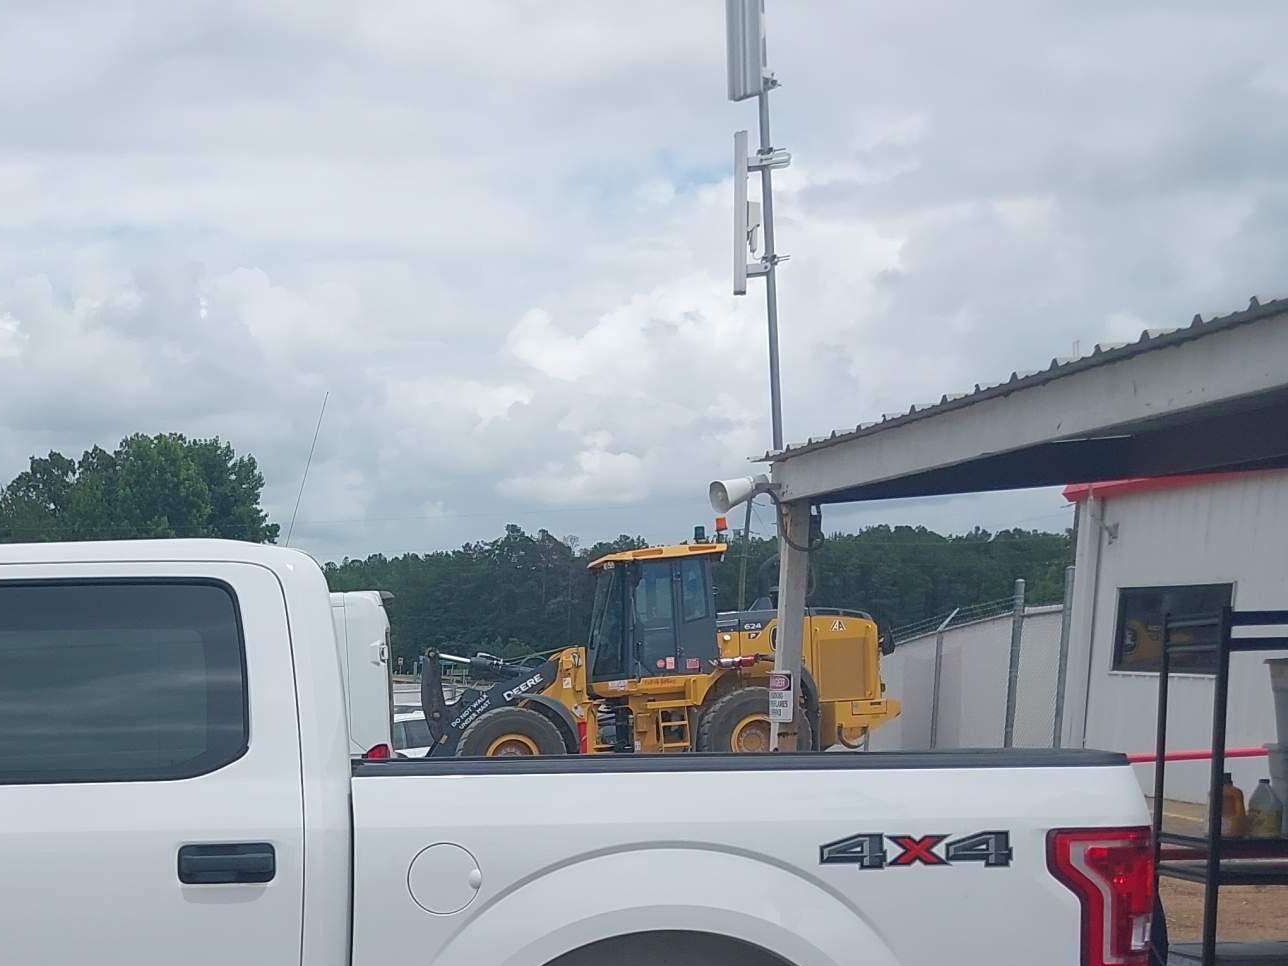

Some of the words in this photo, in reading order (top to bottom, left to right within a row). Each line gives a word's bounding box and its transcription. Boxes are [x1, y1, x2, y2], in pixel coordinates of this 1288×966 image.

[744, 622, 762, 630] 624
[503, 673, 544, 702] DEERE
[451, 718, 461, 728] DO
[460, 707, 472, 719] NOT
[471, 693, 488, 708] WALK
[459, 713, 477, 729] UNDER
[476, 700, 491, 713] MAST
